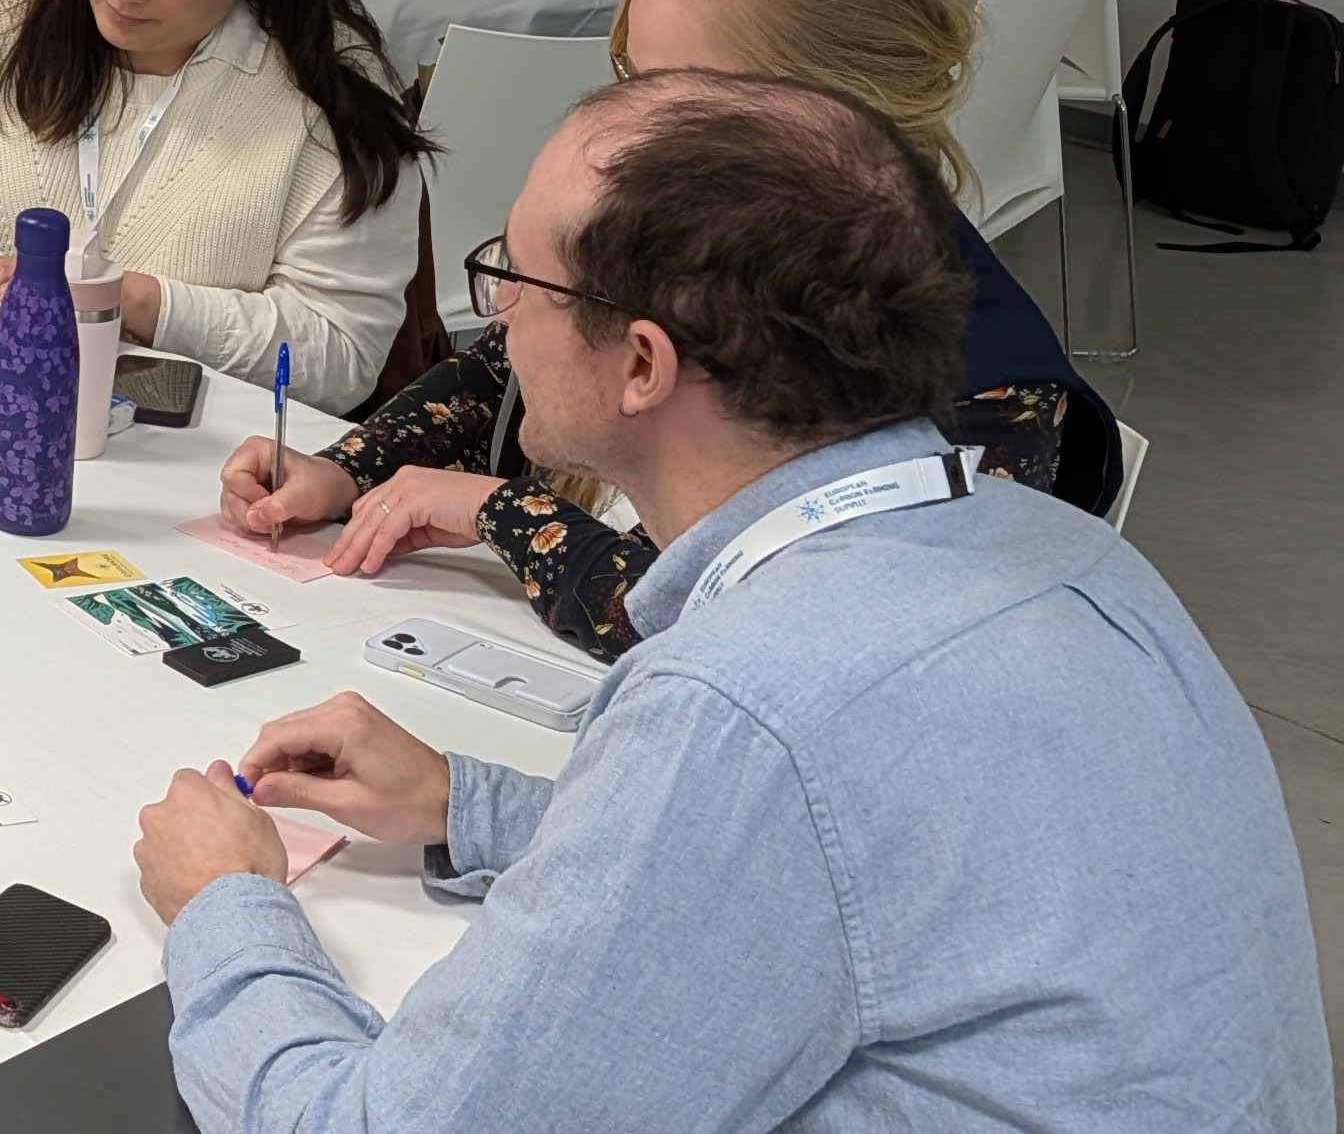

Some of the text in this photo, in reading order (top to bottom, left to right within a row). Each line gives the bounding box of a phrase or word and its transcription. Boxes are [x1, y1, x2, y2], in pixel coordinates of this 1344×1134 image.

[823, 480, 868, 498] EUROPEAN
[829, 481, 900, 506] CARBON FARMING
[833, 498, 867, 514] SUMMIT
